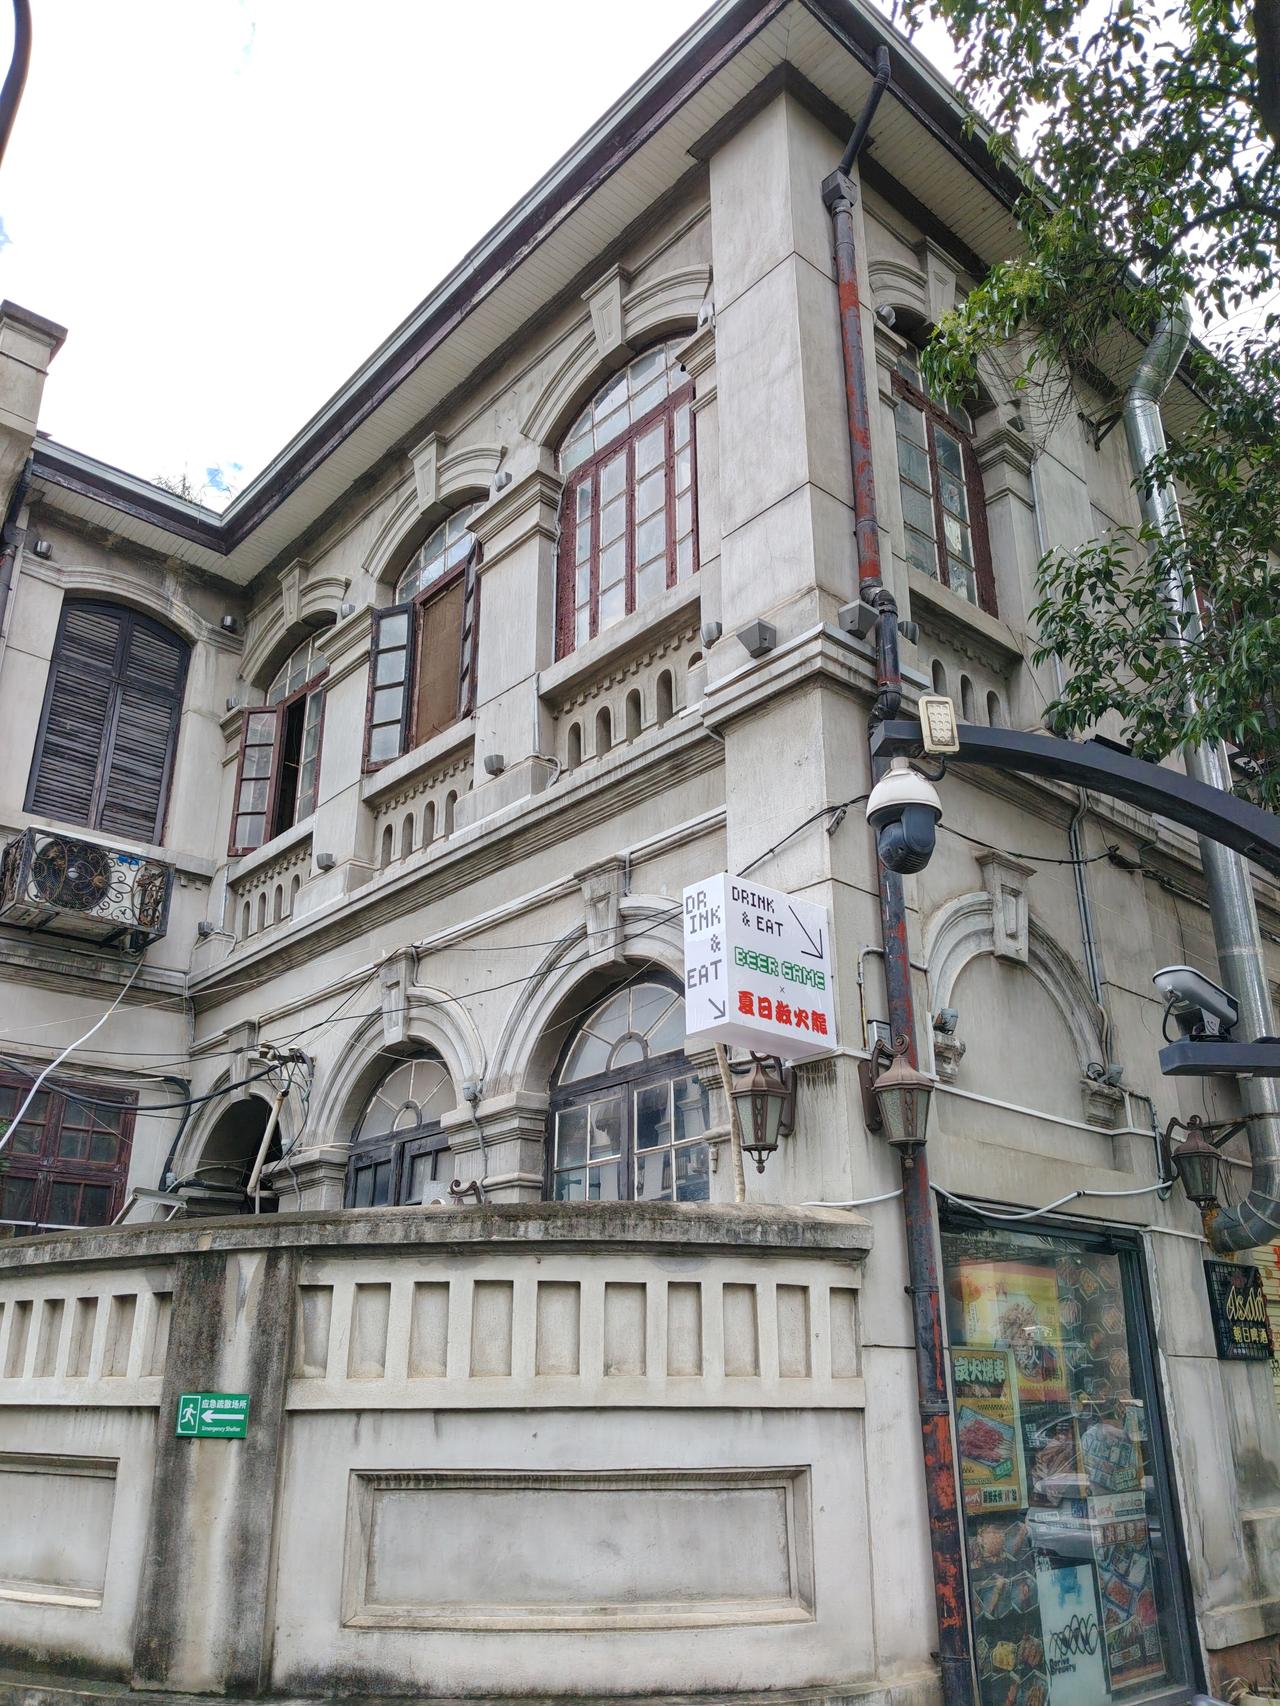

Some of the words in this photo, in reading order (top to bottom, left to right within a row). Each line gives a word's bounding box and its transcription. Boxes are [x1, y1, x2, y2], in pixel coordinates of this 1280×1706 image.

[685, 890, 707, 914] DR
[732, 886, 775, 913] DRINK
[690, 905, 721, 934] INK
[741, 911, 751, 927] &
[756, 917, 784, 937] EAT
[710, 934, 722, 953] &
[687, 959, 723, 990] EAT
[735, 946, 779, 977] BEER
[781, 961, 826, 991] GAME
[1226, 1286, 1266, 1322] Asahi
[1233, 1326, 1269, 1345] 朝日啤酒
